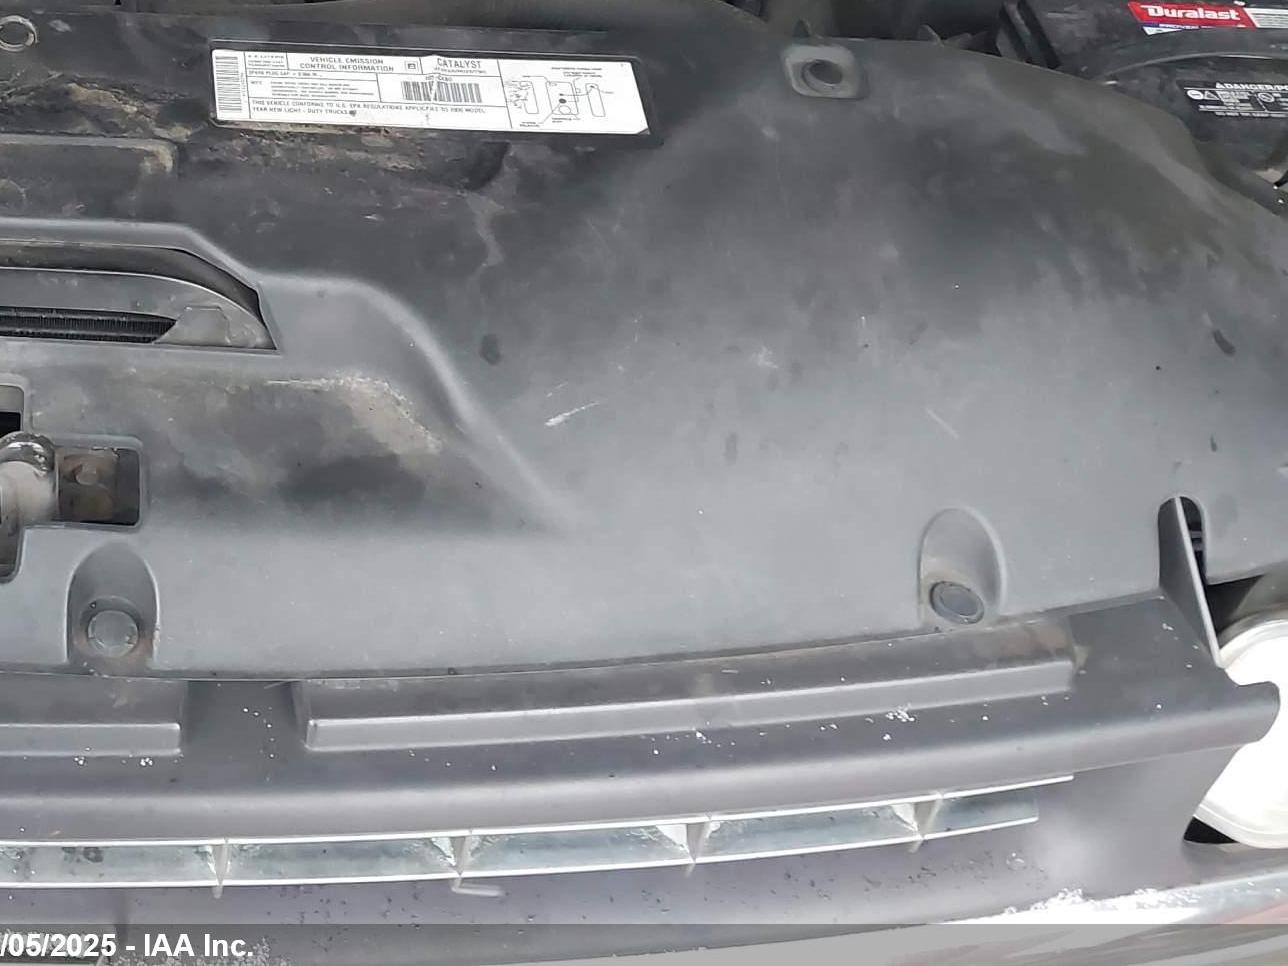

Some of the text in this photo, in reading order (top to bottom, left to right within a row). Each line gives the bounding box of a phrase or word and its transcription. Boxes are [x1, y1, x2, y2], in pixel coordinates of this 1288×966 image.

[1140, 4, 1241, 21] Duralast
[310, 56, 384, 65] VEHICLE EMISSION
[436, 57, 482, 69] CATALYST
[300, 62, 395, 72] CONTROL INFORMATION
